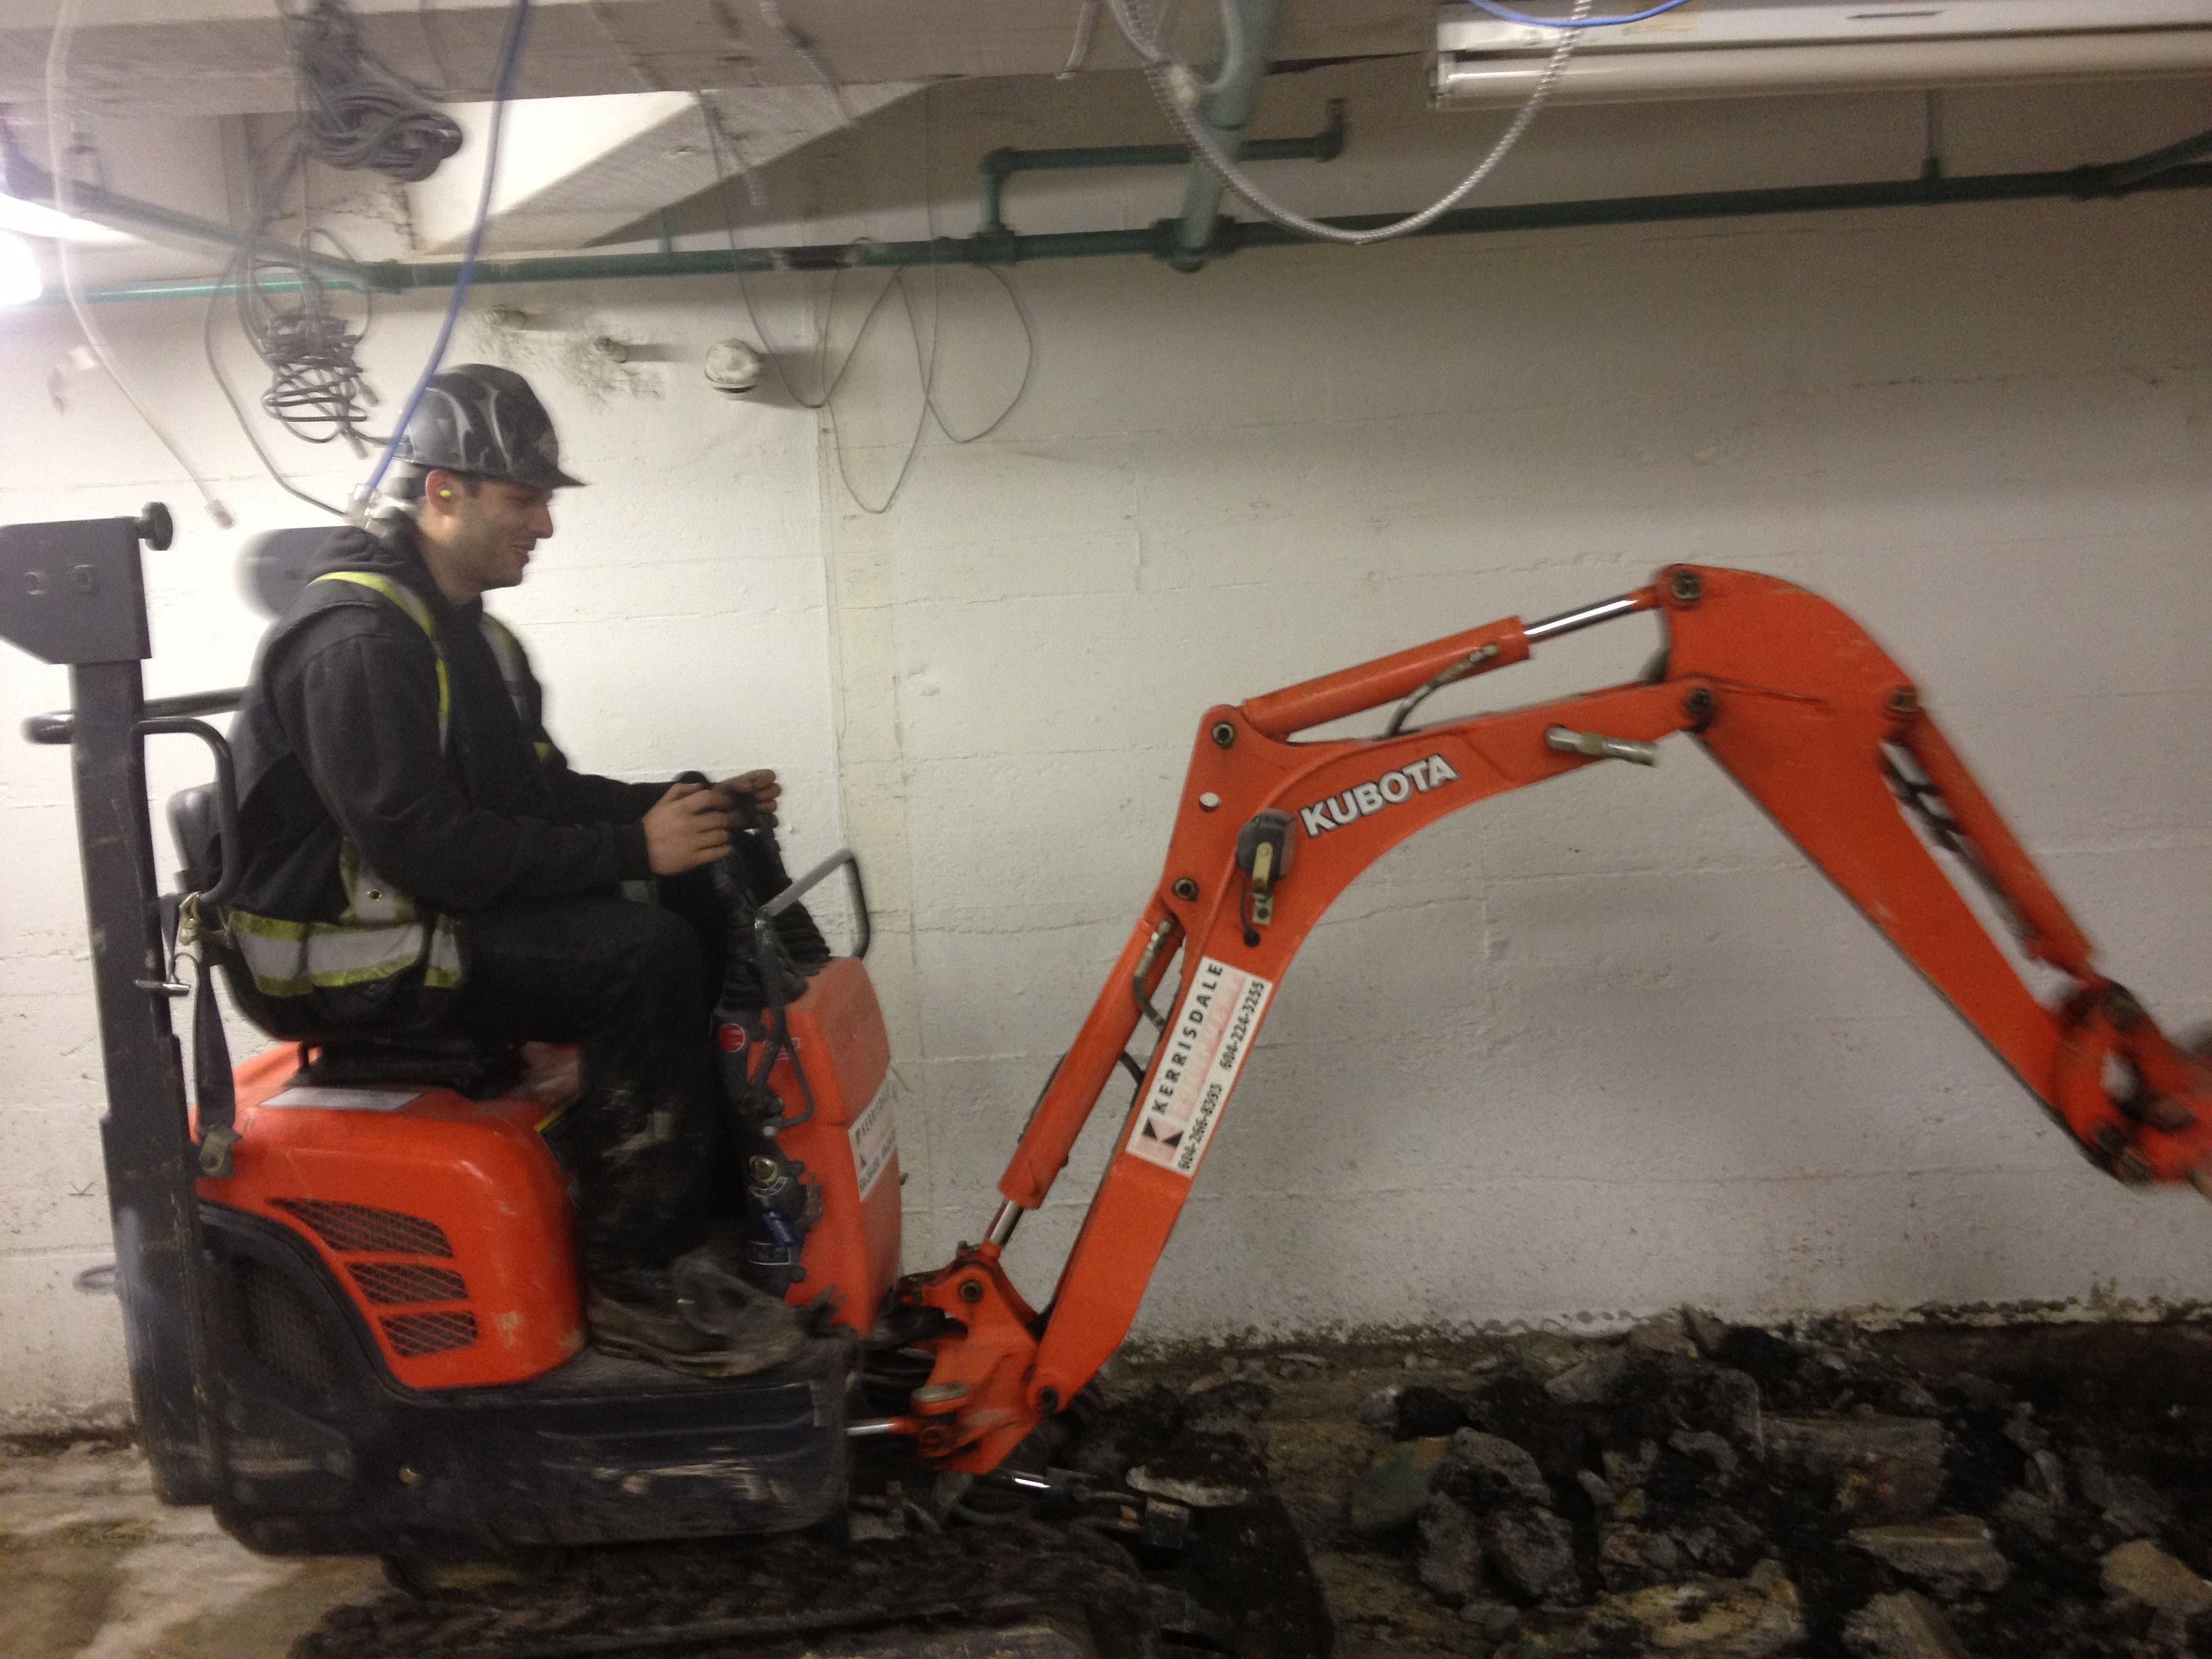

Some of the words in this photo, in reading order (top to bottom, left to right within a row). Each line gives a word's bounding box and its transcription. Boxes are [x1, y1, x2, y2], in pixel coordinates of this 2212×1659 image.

[1300, 753, 1460, 837] KUBOTA
[1151, 963, 1223, 1115] KERRISDALE
[1219, 980, 1265, 1071] 604-224-3255
